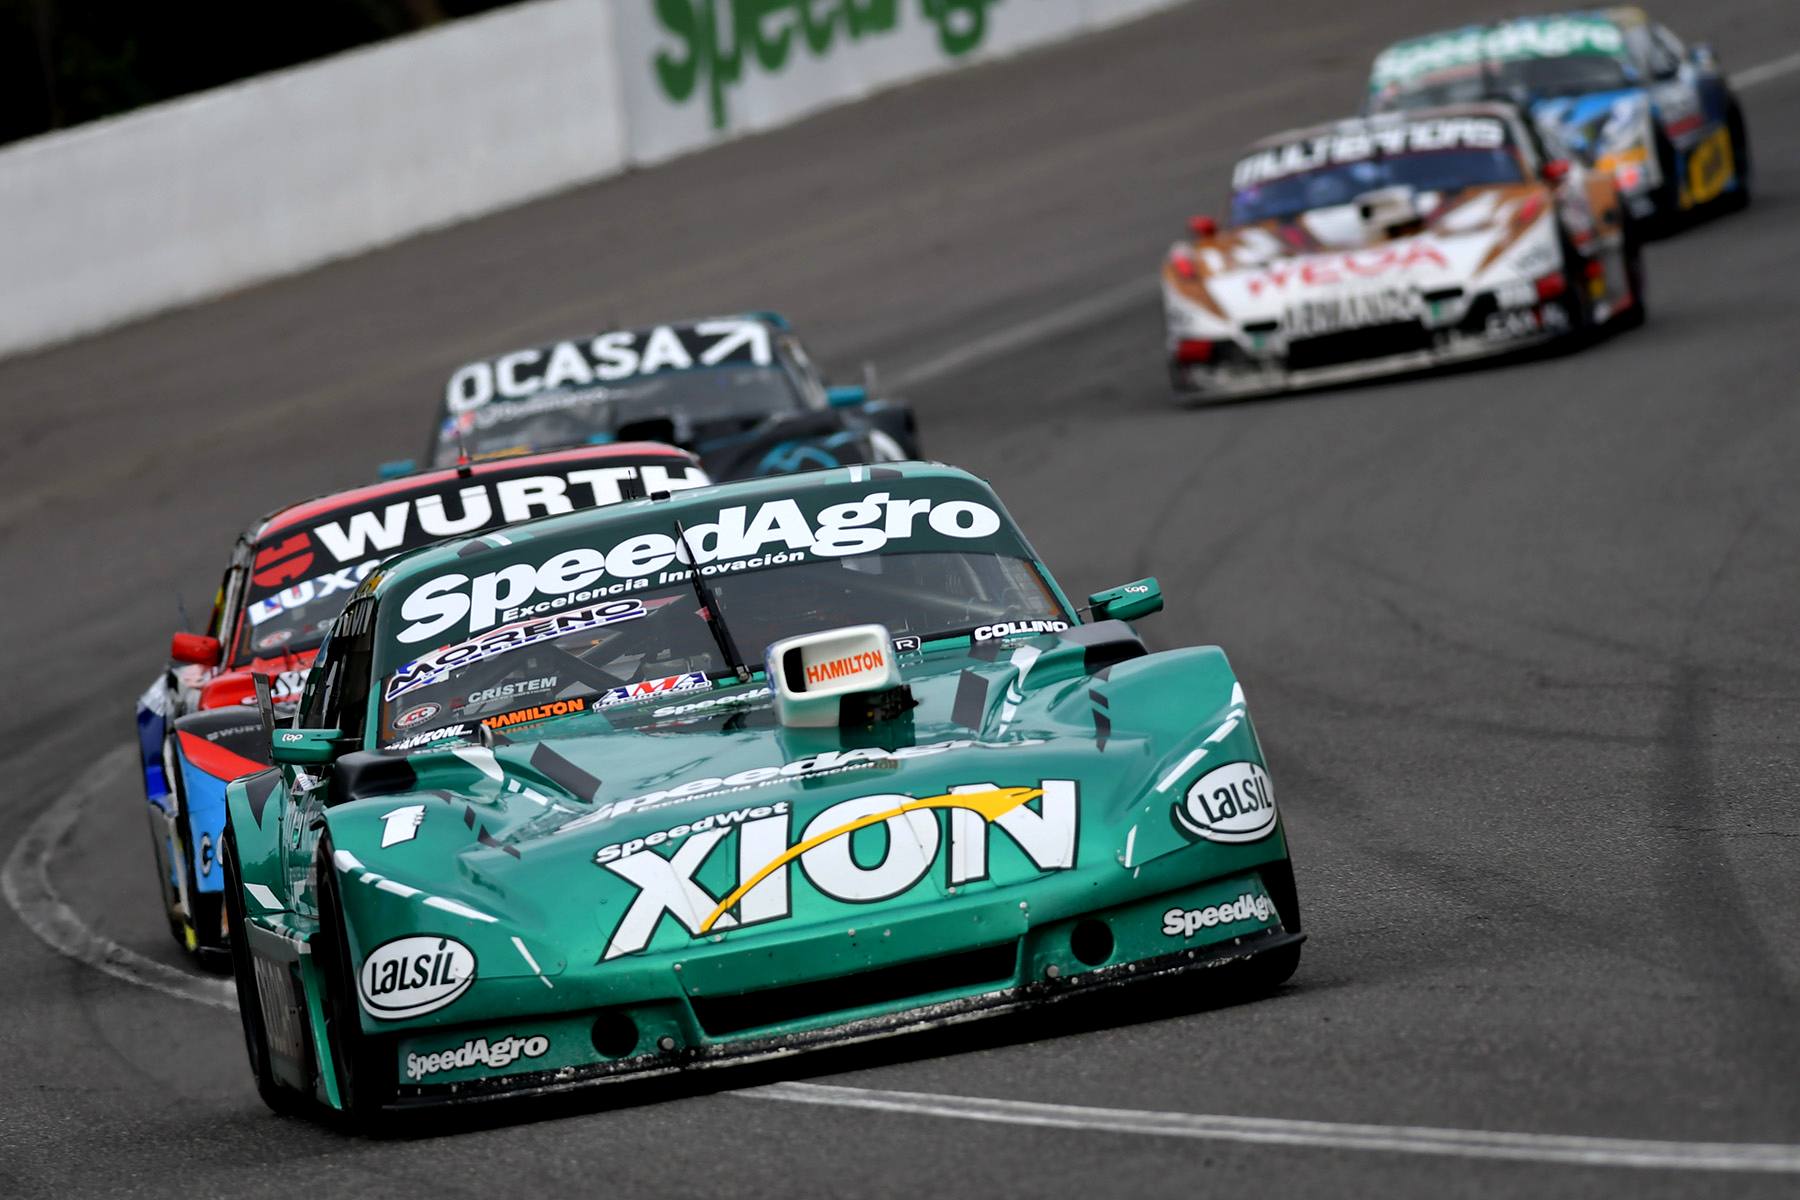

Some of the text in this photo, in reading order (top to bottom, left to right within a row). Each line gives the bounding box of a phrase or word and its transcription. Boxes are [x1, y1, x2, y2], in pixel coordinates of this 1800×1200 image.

[447, 326, 692, 413] OCASA
[395, 492, 1000, 644] SpeedAgro
[502, 551, 805, 622] Excelencia Innovación
[1124, 585, 1149, 594] top
[388, 600, 641, 695] MORENO
[974, 620, 1069, 641] COLLINO
[806, 650, 884, 684] HAMILTON
[468, 676, 557, 704] CRISTEM
[481, 698, 585, 729] HAMILTON
[281, 732, 304, 743] top
[595, 801, 789, 864] SpeedWet
[597, 778, 1080, 963] XION
[406, 1036, 549, 1081] SpeedAgro
